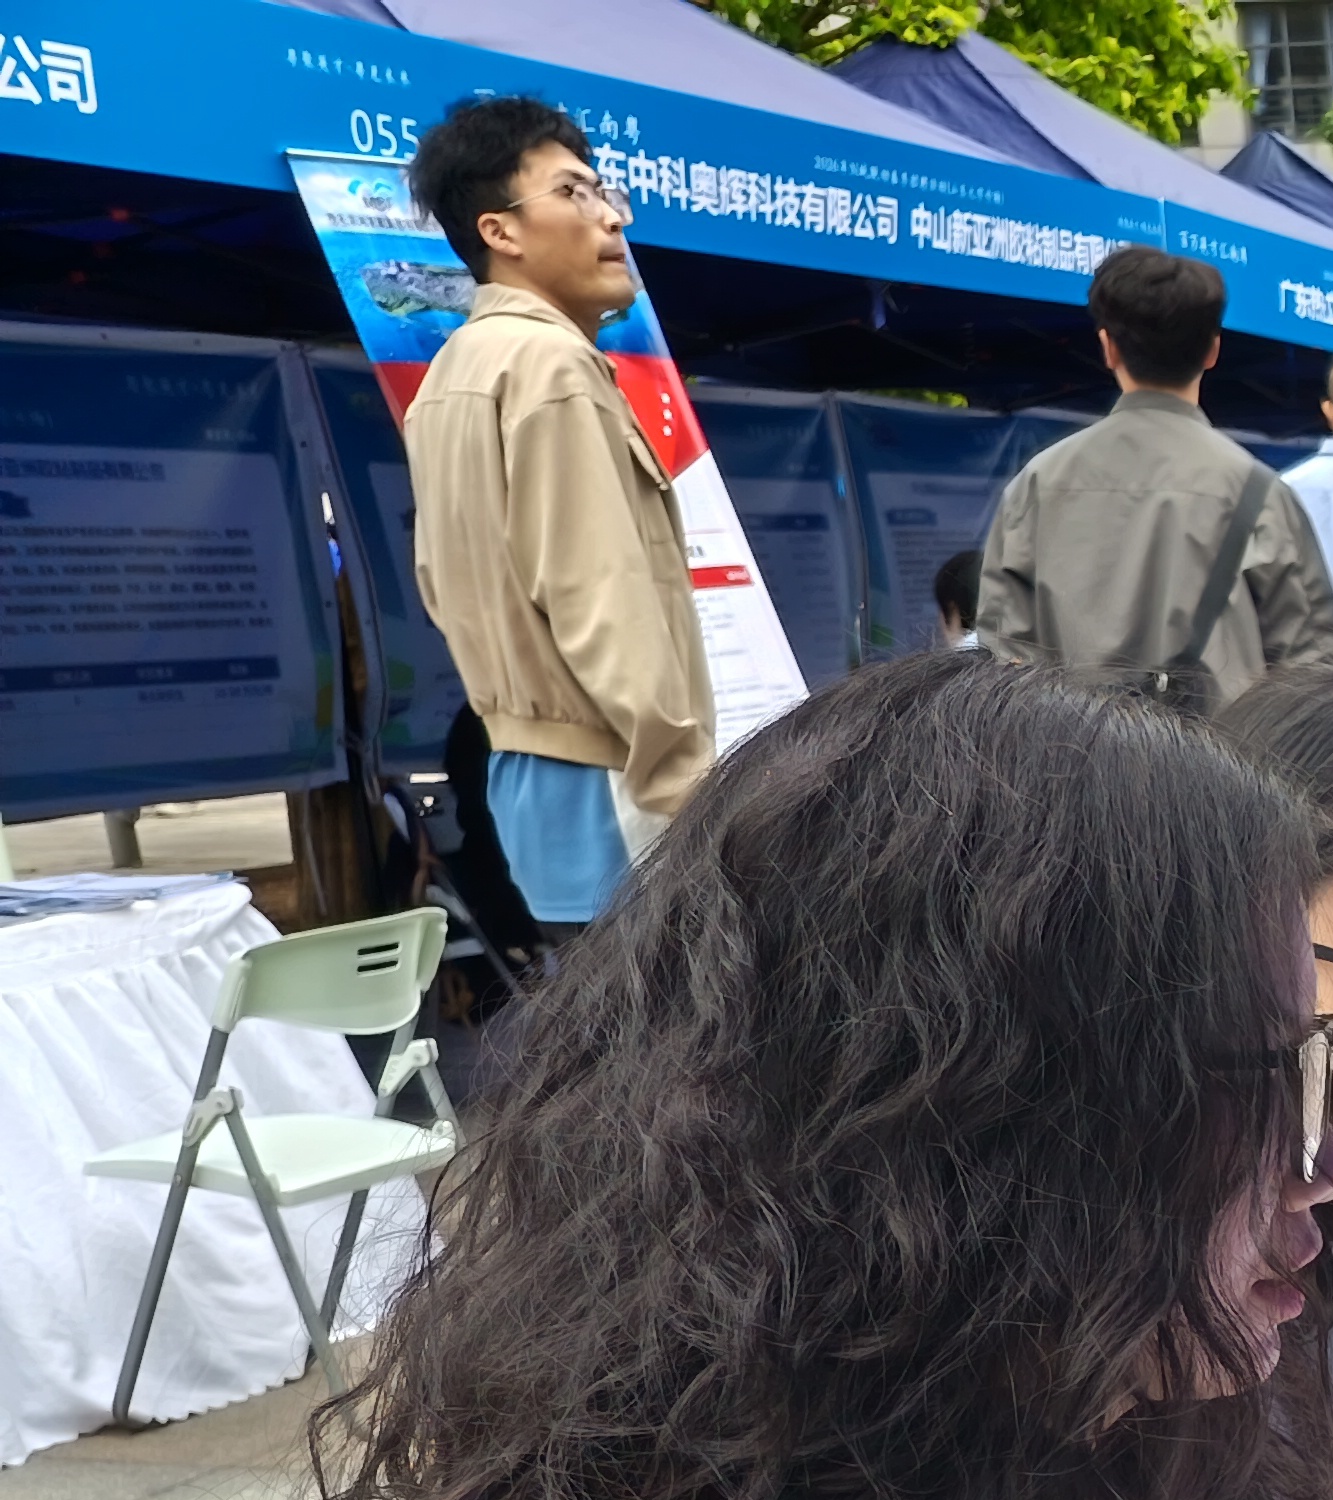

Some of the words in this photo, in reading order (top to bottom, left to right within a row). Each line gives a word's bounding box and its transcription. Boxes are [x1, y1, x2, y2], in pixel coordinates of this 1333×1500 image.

[0, 33, 98, 115] 公司
[911, 202, 1133, 277] 中山新亚洲胶粘制品有限
